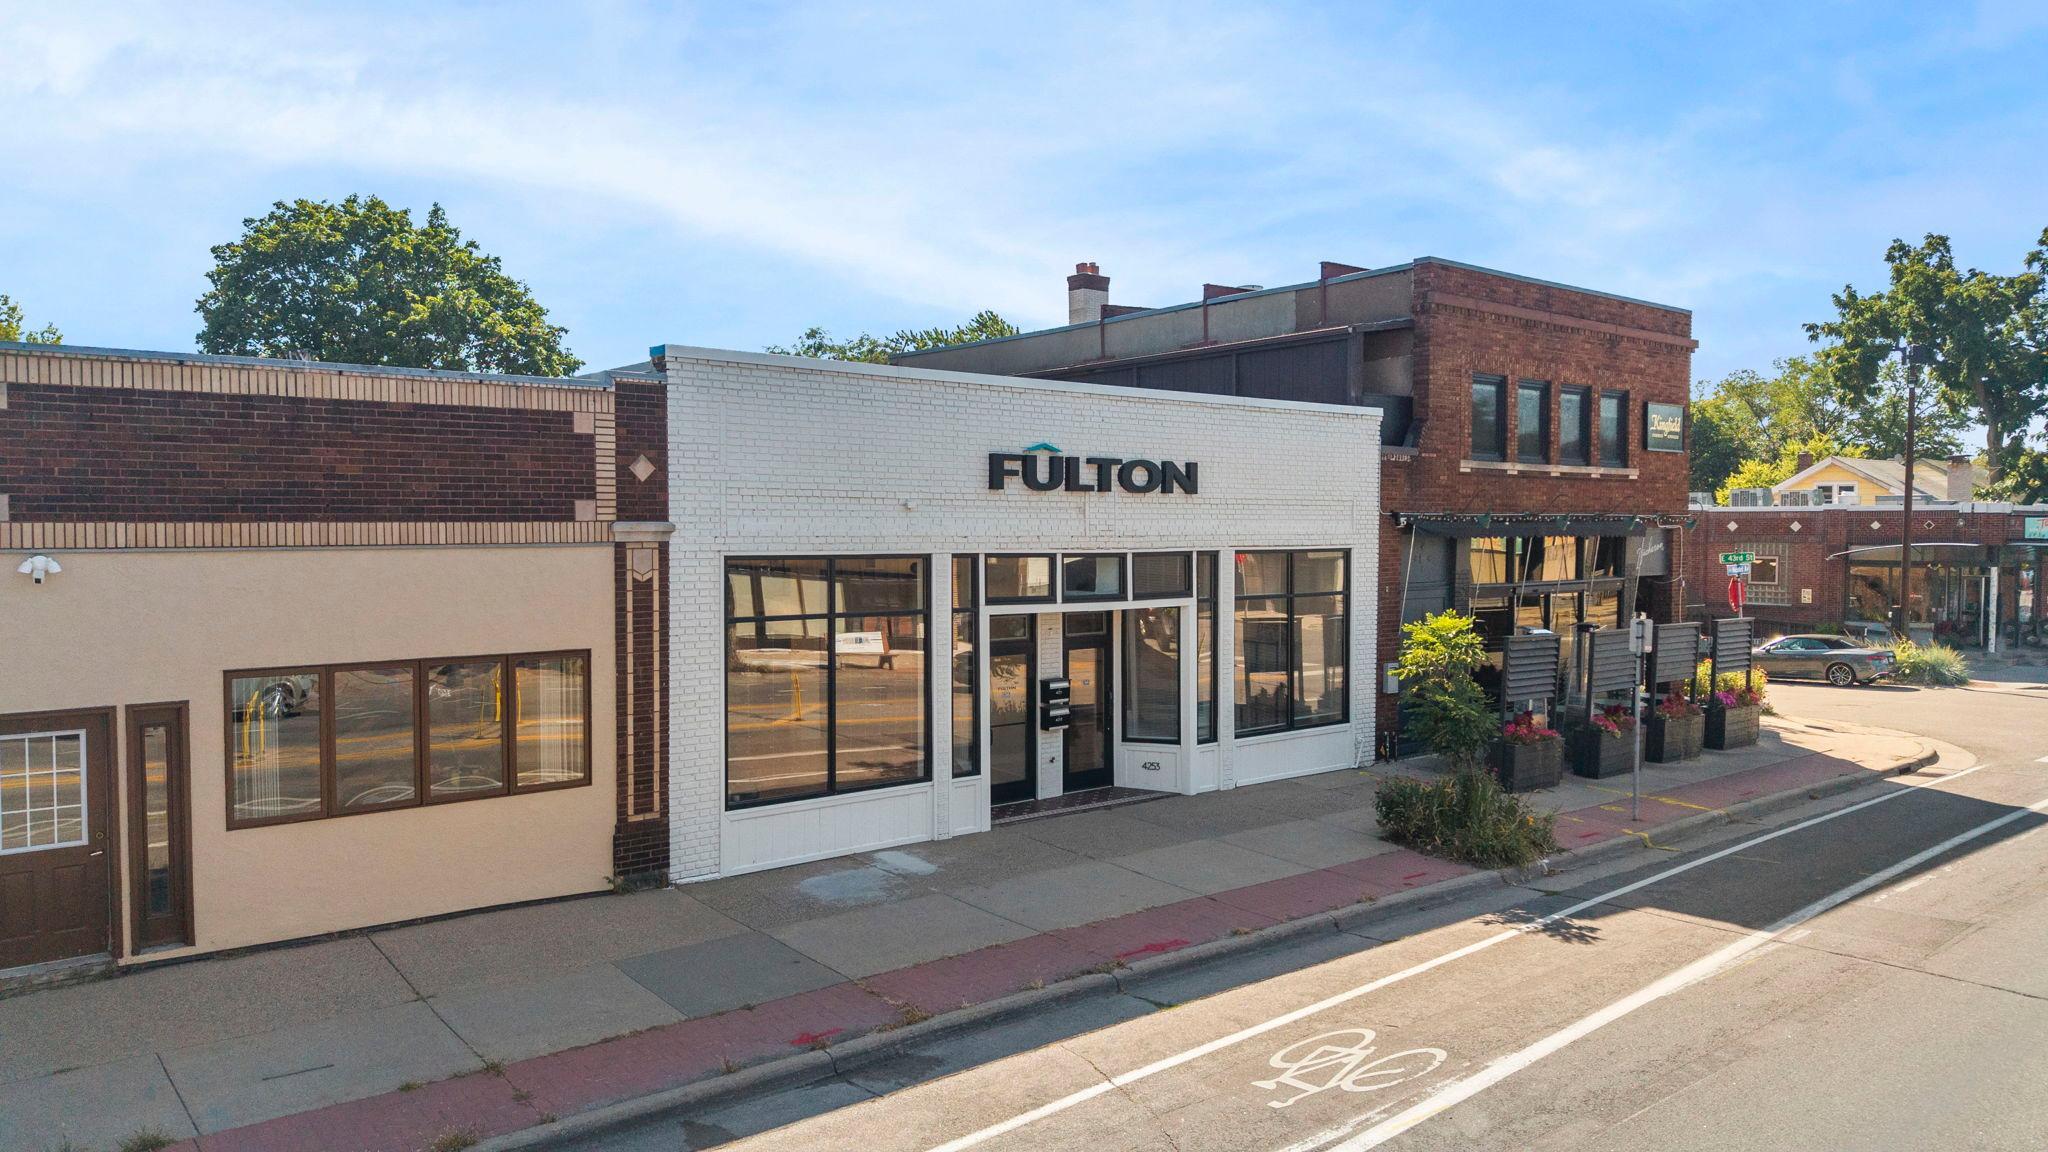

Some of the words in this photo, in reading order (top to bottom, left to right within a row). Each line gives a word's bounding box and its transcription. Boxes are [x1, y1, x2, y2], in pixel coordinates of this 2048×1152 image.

[988, 452, 1199, 495] FULTON
[1727, 554, 1744, 562] 43rd
[1141, 761, 1161, 771] 4253
